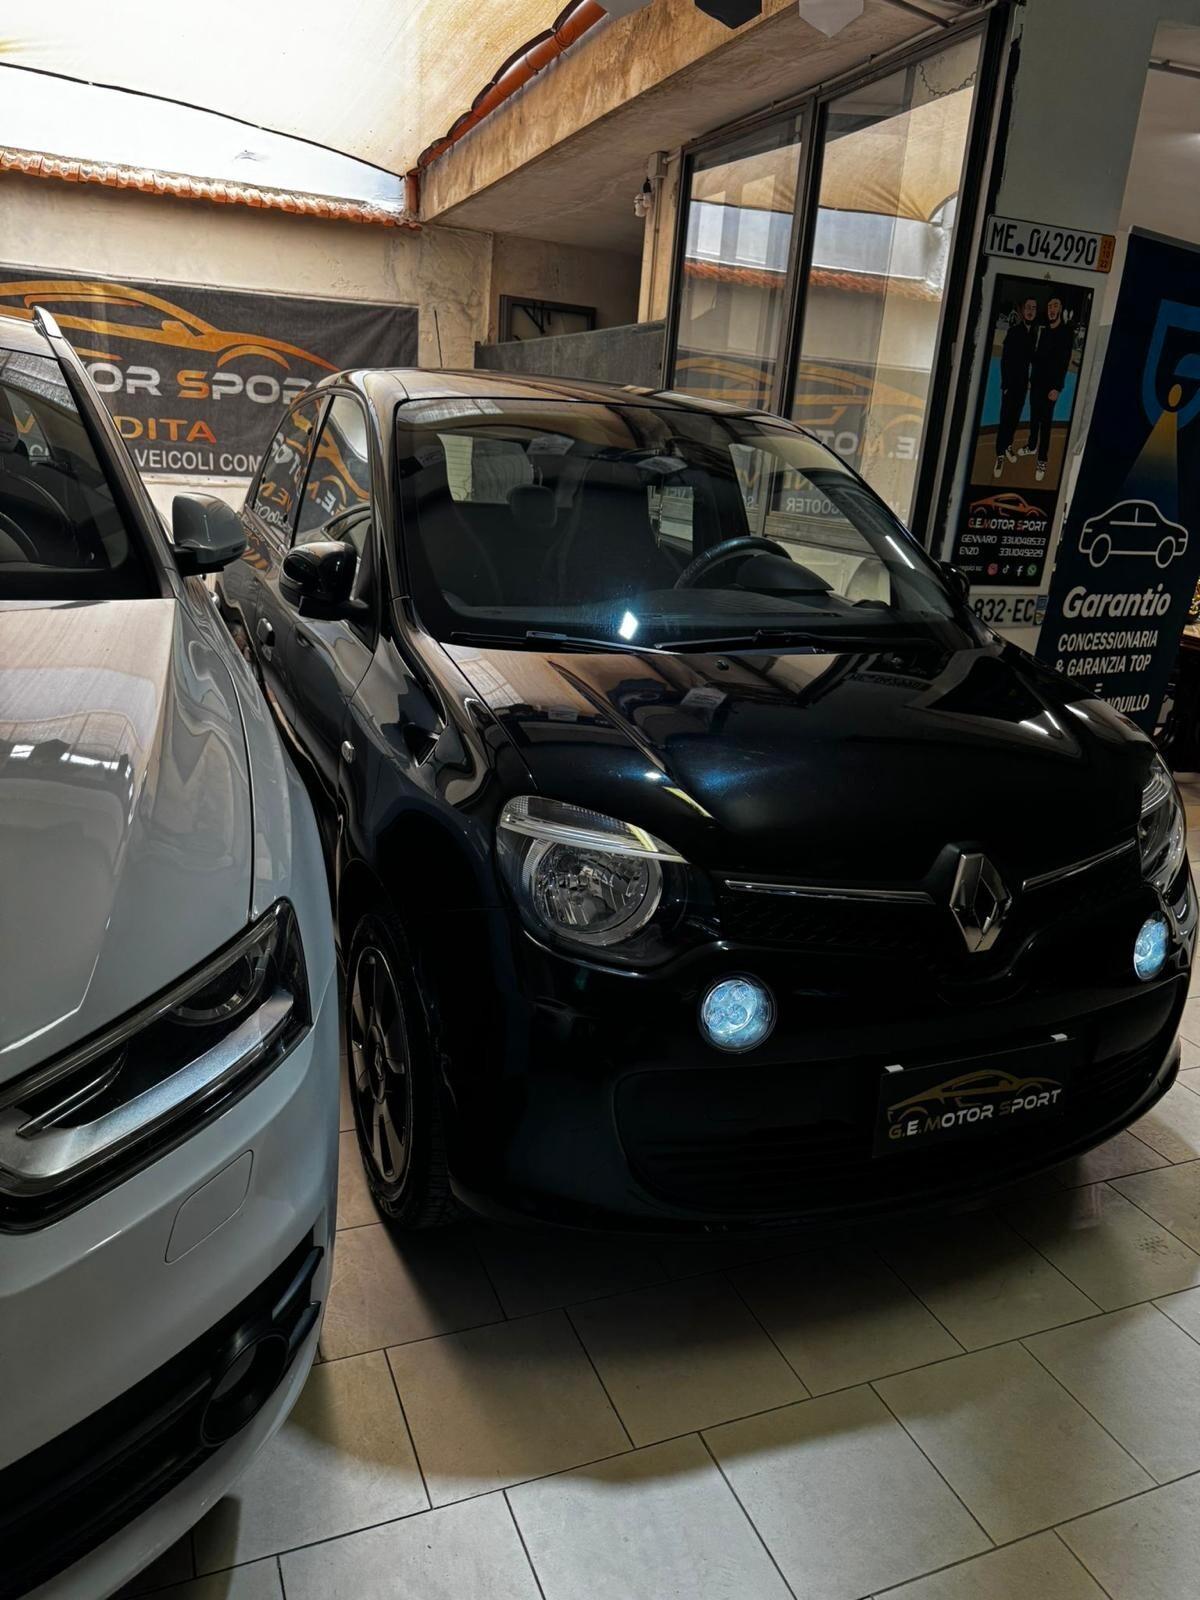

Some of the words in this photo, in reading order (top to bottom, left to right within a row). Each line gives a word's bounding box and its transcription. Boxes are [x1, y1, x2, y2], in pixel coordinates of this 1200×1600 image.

[82, 361, 162, 396] OR
[114, 415, 217, 444] DITA
[135, 449, 214, 471] VEICOLI
[219, 453, 262, 473] COM
[1016, 520, 1048, 532] SPORT
[961, 534, 998, 544] GENNARO
[959, 547, 979, 556] ENZO
[1062, 583, 1172, 619] Garantio
[1057, 630, 1159, 653] CONCESSIONARIA
[1067, 655, 1127, 676] GARANZIA
[1129, 654, 1151, 672] TOP
[998, 1088, 1063, 1116] SPORT
